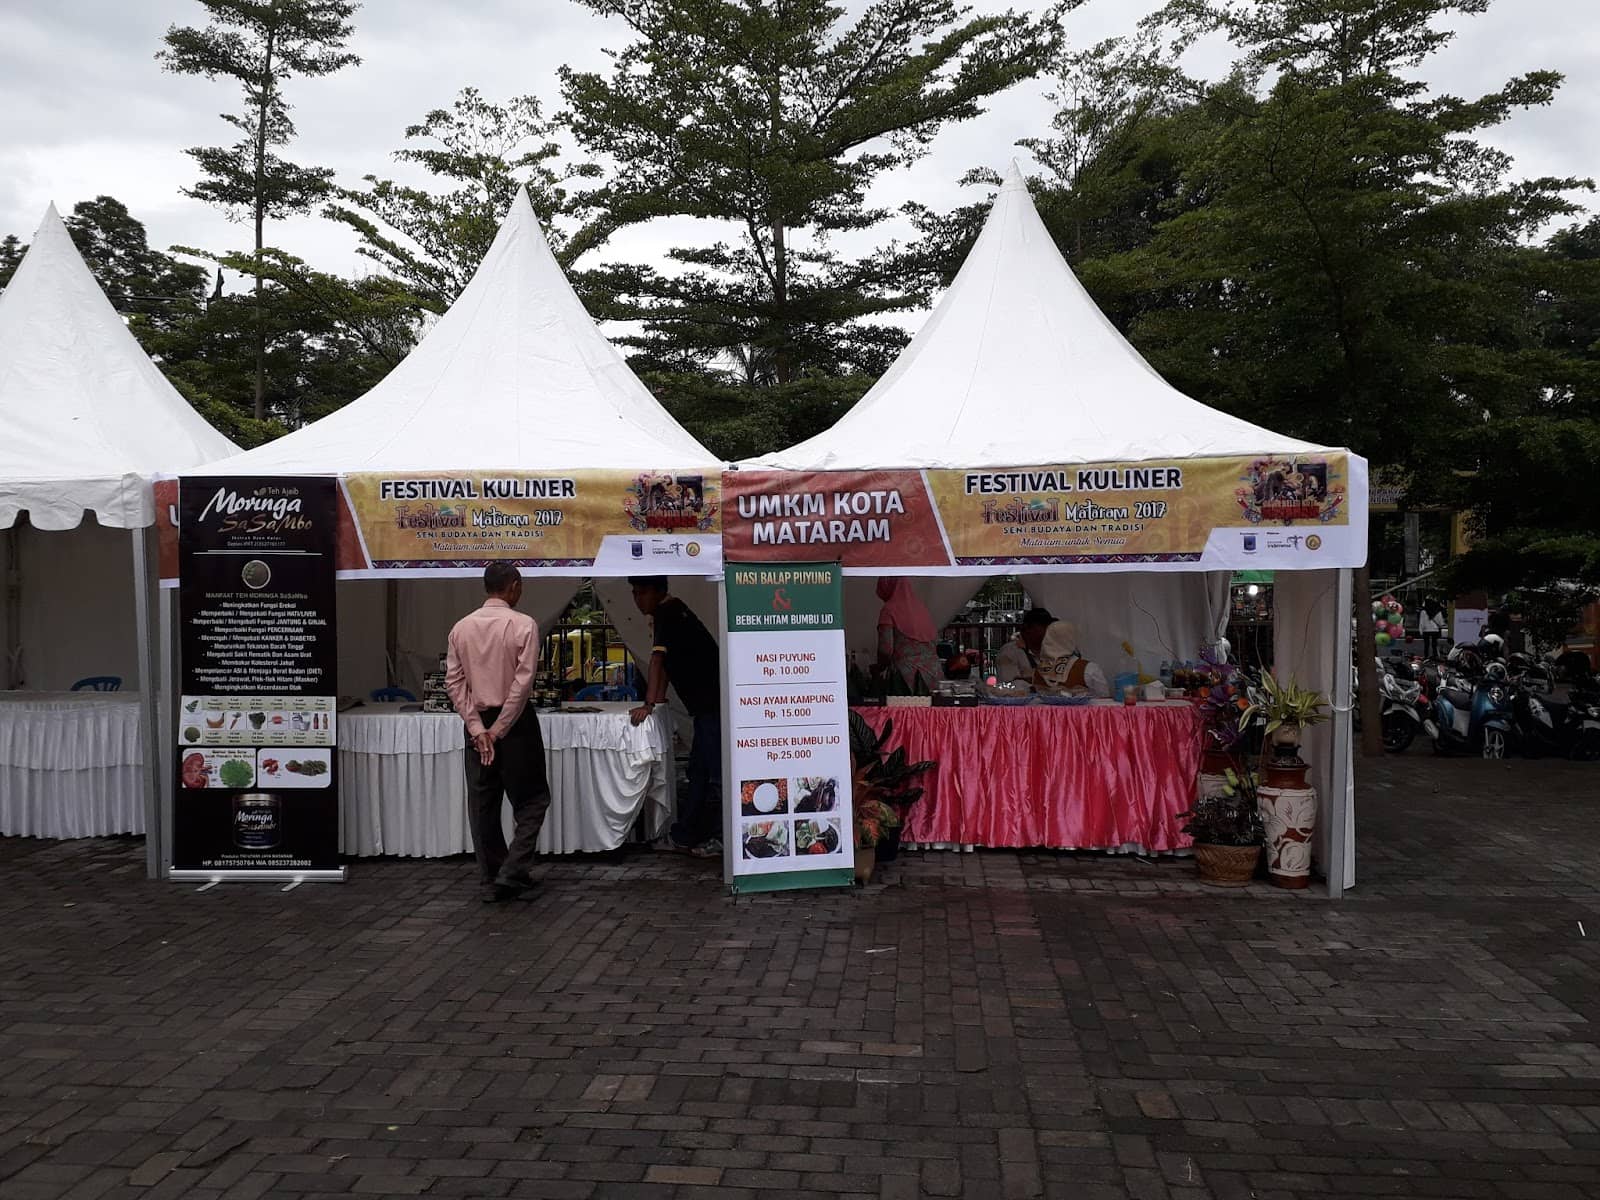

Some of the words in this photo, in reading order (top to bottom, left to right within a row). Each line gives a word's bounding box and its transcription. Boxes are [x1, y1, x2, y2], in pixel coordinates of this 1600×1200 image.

[966, 472, 1071, 494] FESTIVAL
[1078, 468, 1181, 490] KULINER
[268, 487, 279, 495] Teh
[282, 488, 299, 496] Ajaib
[380, 480, 478, 499] FESTIVAL
[483, 480, 575, 498] KULINER
[199, 487, 301, 522] Moringa
[739, 494, 825, 517] UMKM
[834, 491, 904, 514] KOTA
[396, 503, 466, 529] Festival
[472, 506, 529, 528] Mataram
[535, 511, 563, 525] 2017
[982, 498, 1059, 524] Festival
[1066, 499, 1128, 523] Mataram
[1135, 501, 1166, 519] 2017
[754, 519, 890, 544] MATARAM
[1003, 526, 1027, 534] SENI
[1102, 524, 1144, 532] TRADISI
[736, 572, 757, 584] NASI
[761, 572, 790, 584] BALAP
[794, 572, 831, 584] PUYUNG
[772, 589, 791, 610] &
[736, 615, 761, 625] BEBEK
[764, 615, 788, 625] HITAM
[791, 614, 819, 624] BUMBU
[822, 614, 833, 624] IJO
[756, 654, 776, 662] NASI
[780, 653, 815, 662] PUYUNG
[763, 667, 776, 676] Rp.
[781, 666, 809, 675] 10.000
[740, 697, 760, 705] NASI
[764, 696, 788, 704] AYAM
[791, 695, 834, 704] KAMPUNG
[765, 710, 777, 718] Rp.
[782, 708, 811, 717] 15.000
[737, 739, 758, 748] NASI
[761, 738, 788, 747] BEBEK
[791, 736, 823, 745] BUMBU
[826, 736, 840, 744] IJO
[767, 750, 811, 761] Rp.25.000
